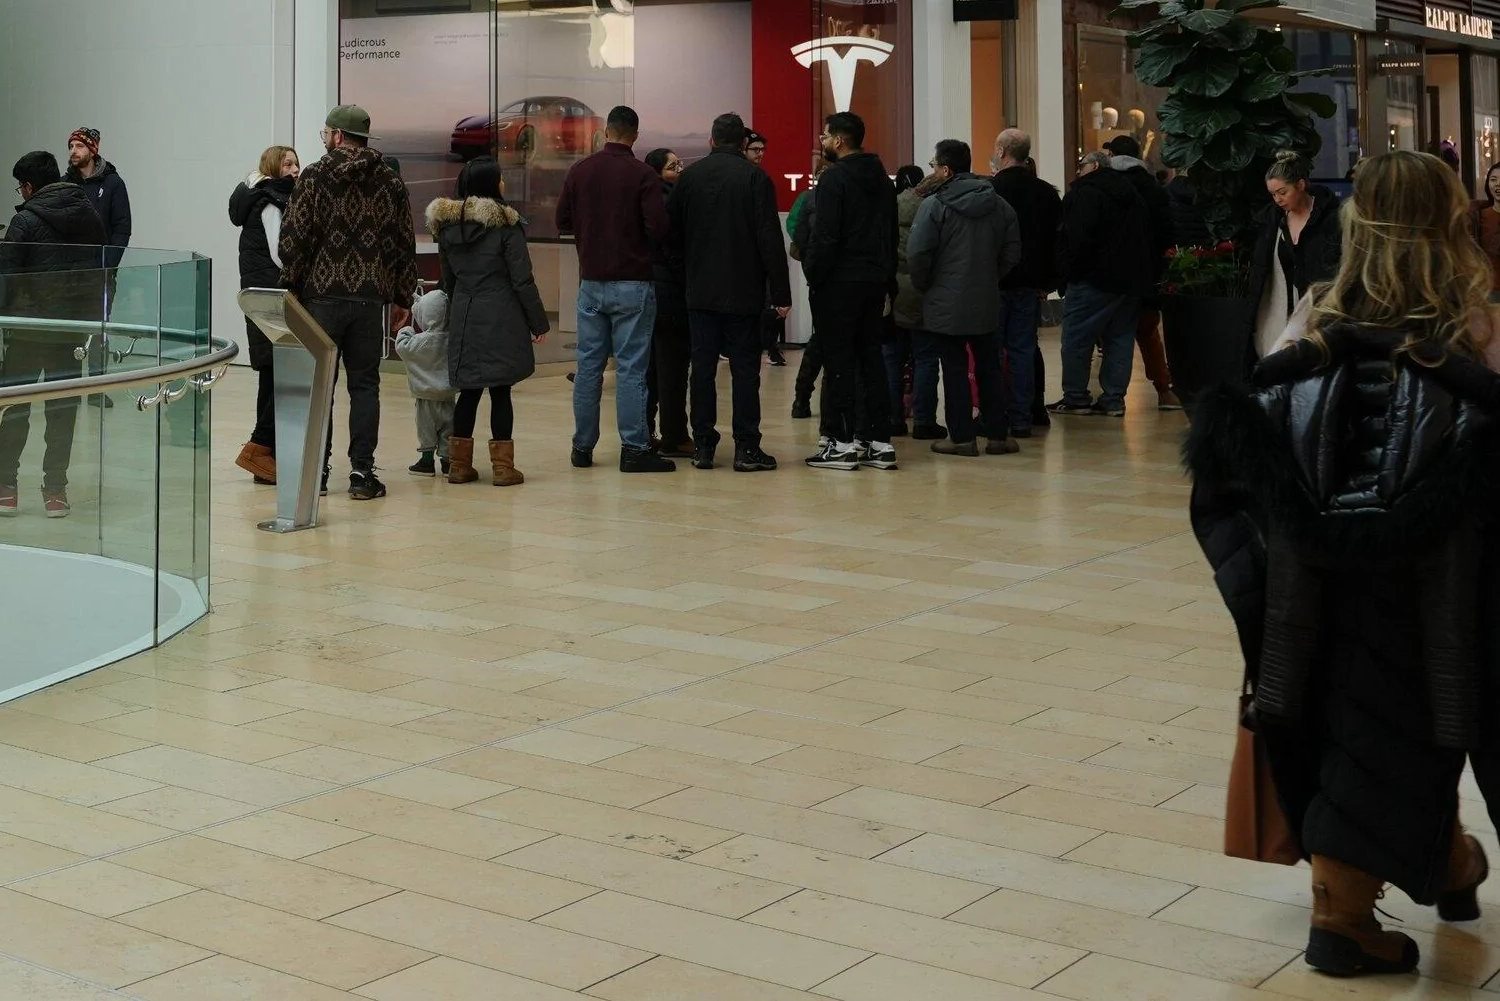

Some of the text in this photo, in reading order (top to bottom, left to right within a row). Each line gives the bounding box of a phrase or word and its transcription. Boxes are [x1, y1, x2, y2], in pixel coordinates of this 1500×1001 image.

[1425, 6, 1493, 39] RALPH LAUREN
[340, 50, 401, 60] Performance
